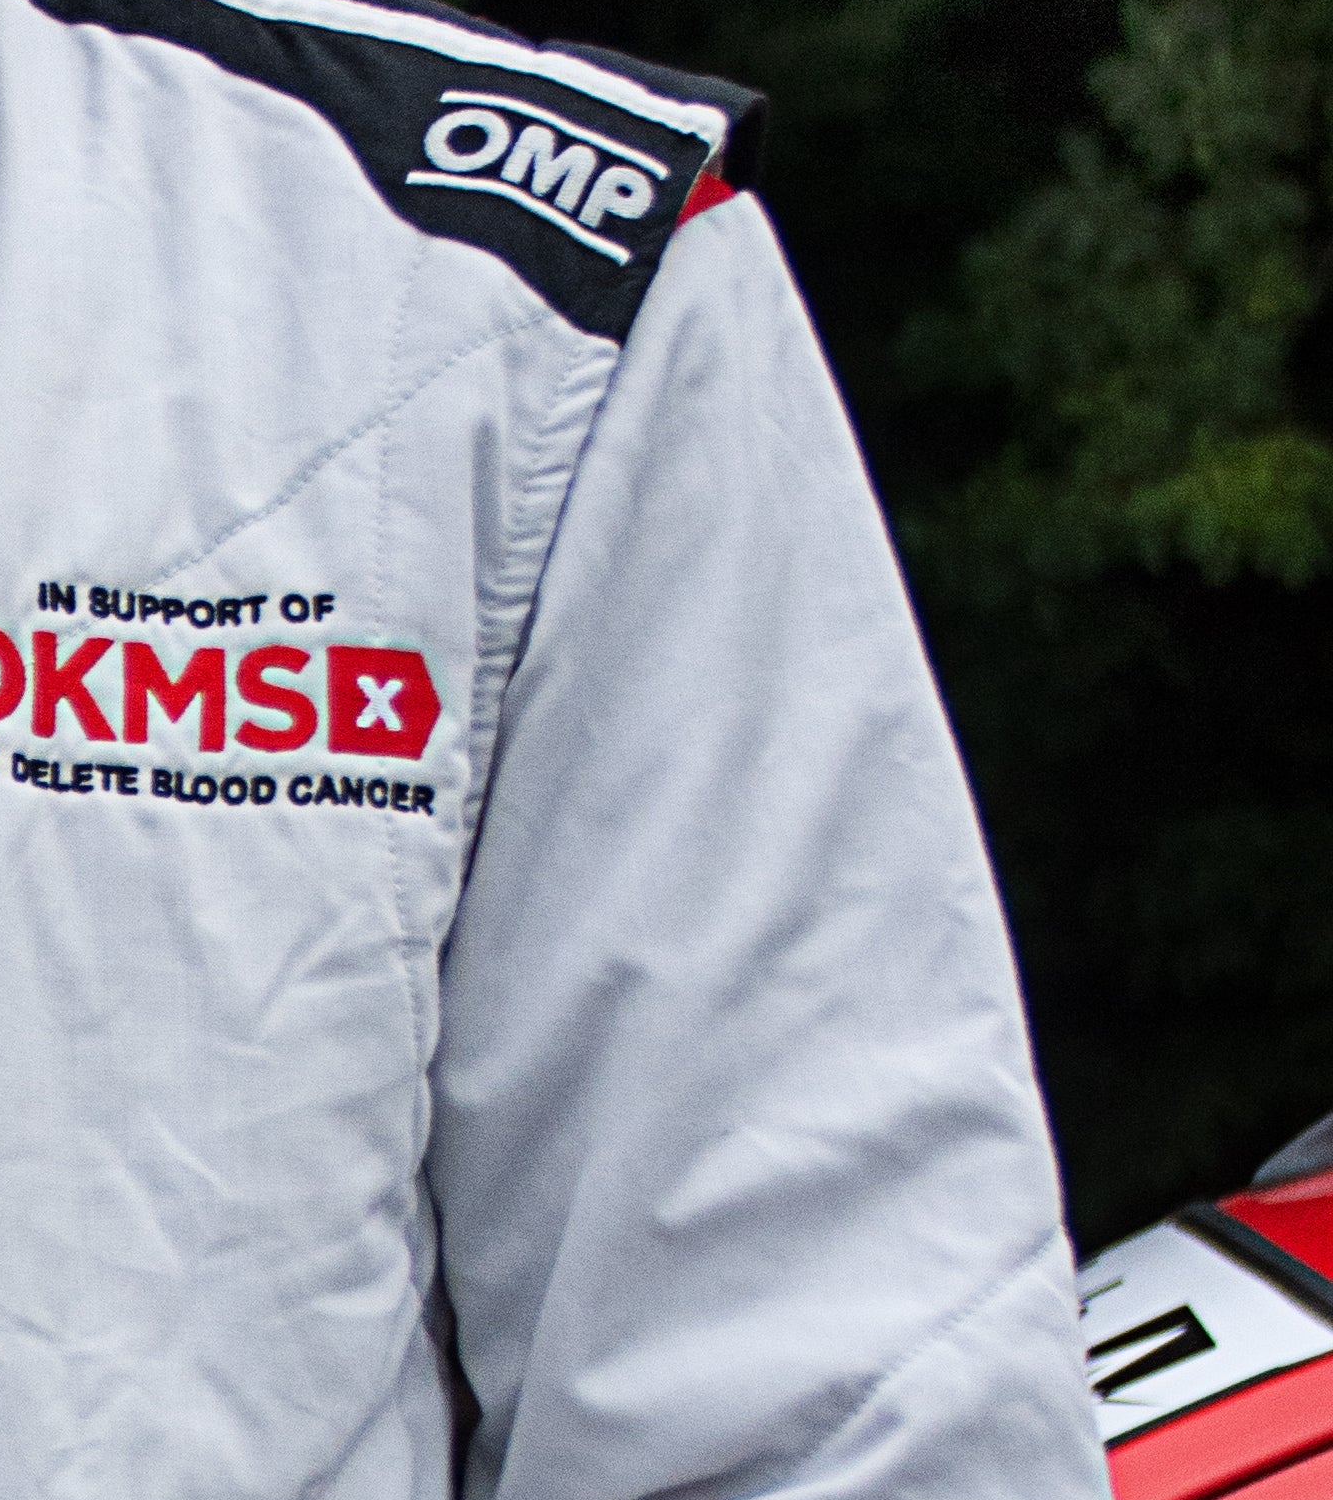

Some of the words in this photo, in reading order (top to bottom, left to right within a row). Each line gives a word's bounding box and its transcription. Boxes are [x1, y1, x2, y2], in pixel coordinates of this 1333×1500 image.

[422, 107, 656, 230] OMP
[37, 580, 77, 615] IN
[88, 586, 269, 629] SUPPORT
[280, 592, 335, 622] OF
[10, 752, 140, 795] DELETE
[150, 768, 277, 807] BLOOD
[287, 776, 435, 817] CANCER
